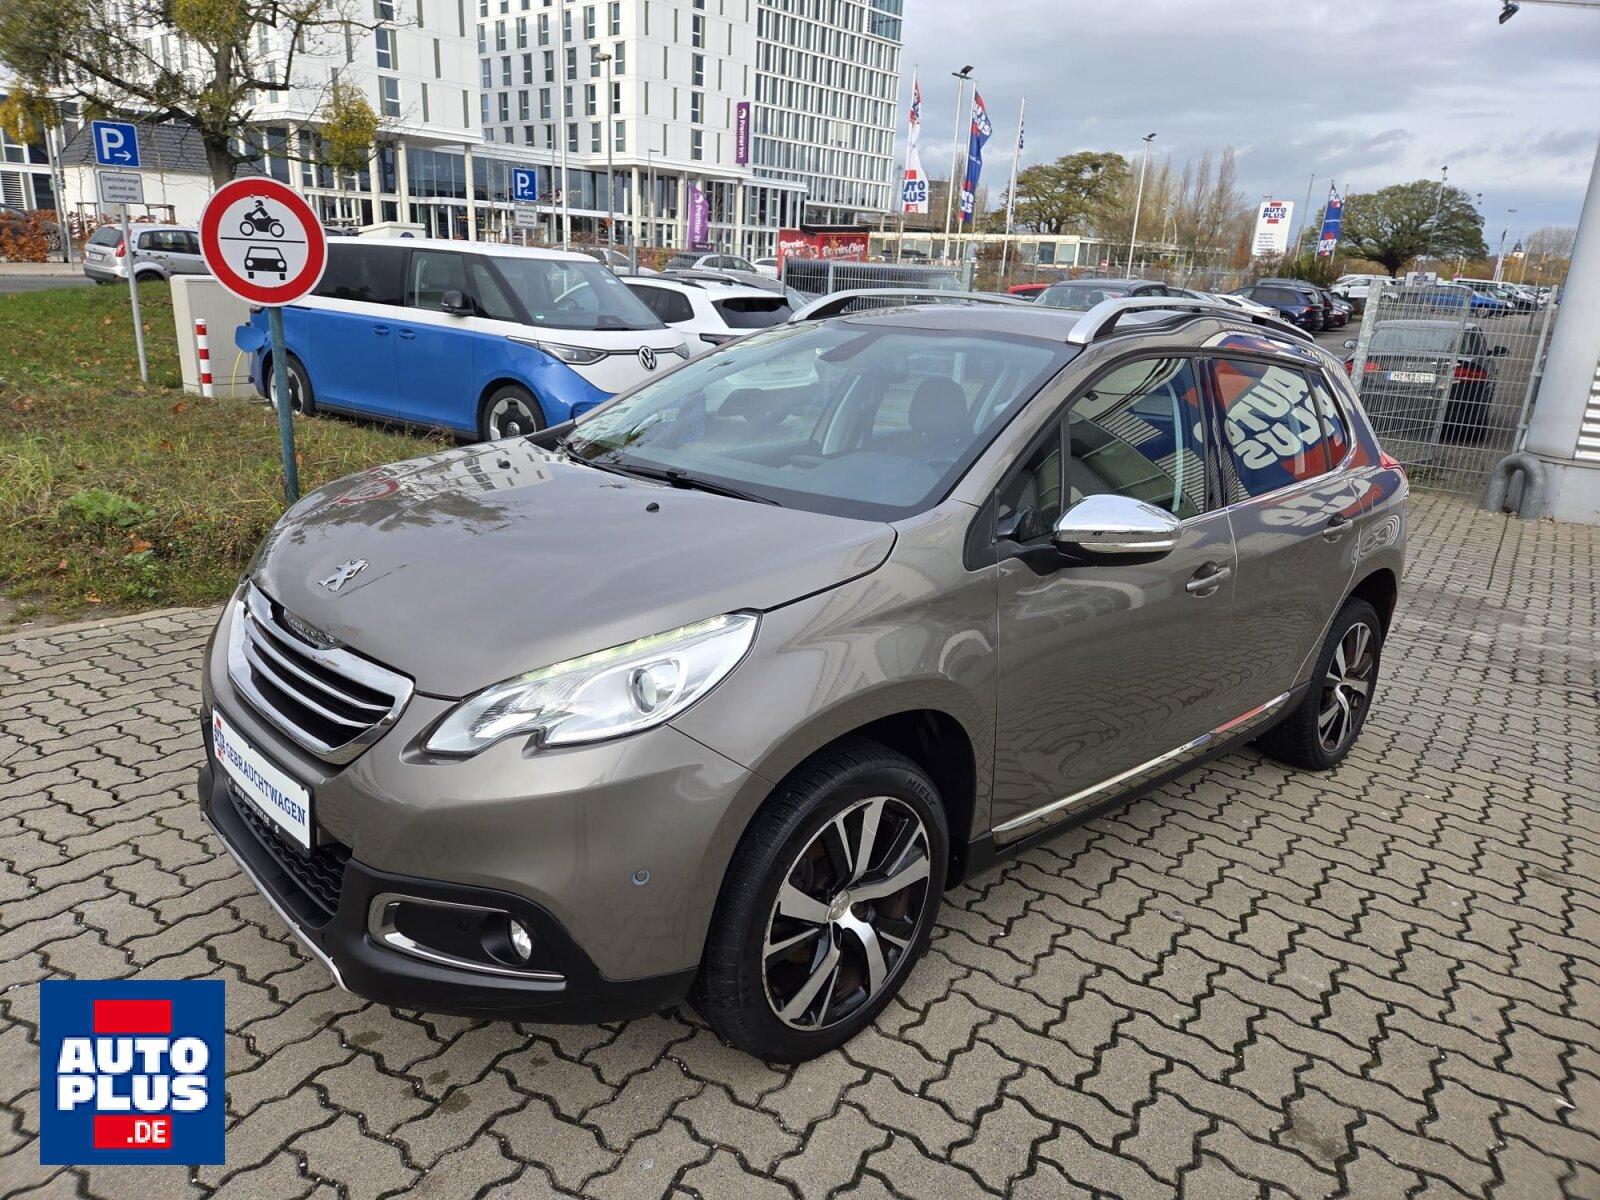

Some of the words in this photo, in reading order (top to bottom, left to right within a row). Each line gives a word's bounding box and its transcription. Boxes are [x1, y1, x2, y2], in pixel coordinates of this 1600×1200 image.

[100, 127, 124, 160] P
[516, 172, 530, 196] P
[694, 205, 702, 233] Premier
[225, 742, 306, 826] GEBRAUCHTWAGEN
